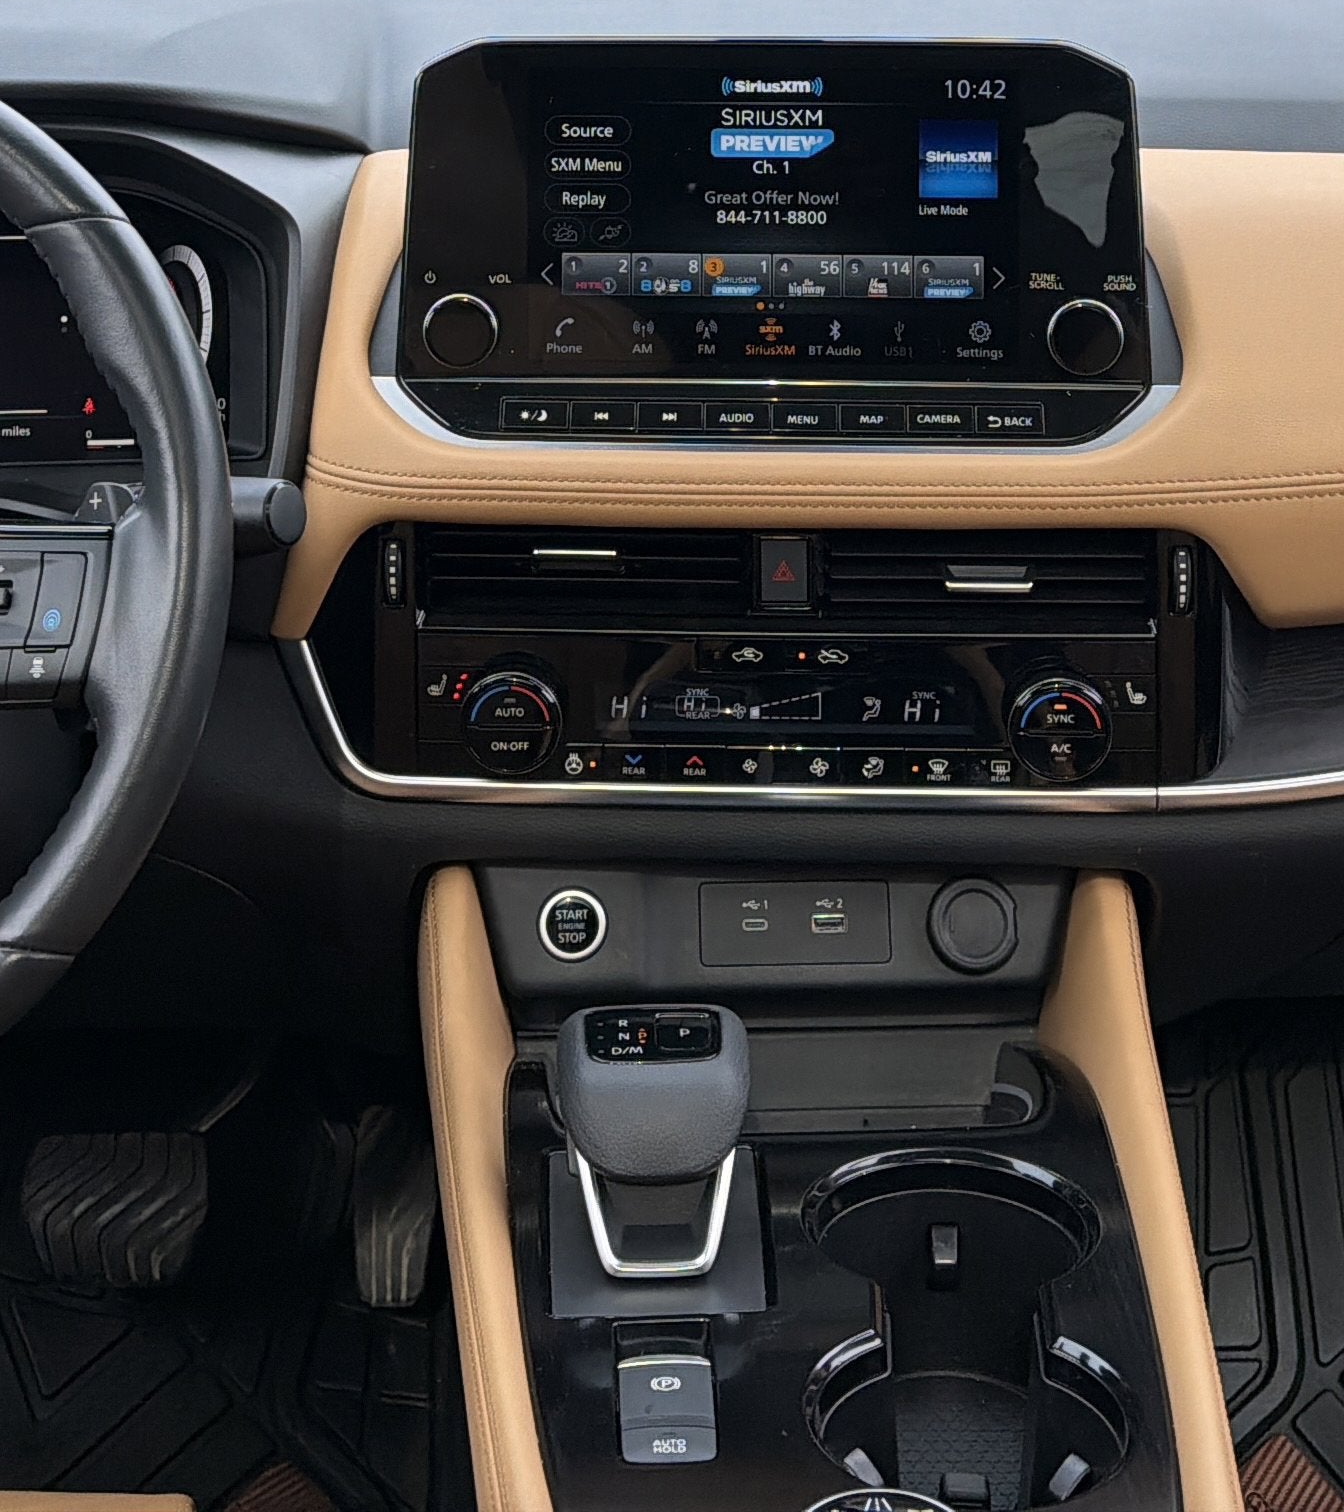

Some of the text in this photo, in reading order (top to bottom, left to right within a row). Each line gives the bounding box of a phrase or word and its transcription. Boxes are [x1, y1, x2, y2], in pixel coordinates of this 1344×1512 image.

[945, 80, 1006, 99] 10:42
[721, 108, 823, 126] SIRIUSXM
[561, 124, 613, 138] Source
[720, 135, 824, 152] PREVIEW
[925, 151, 992, 163] SiriusXM
[551, 158, 622, 172] SXM Menu
[753, 160, 790, 174] Ch. 1
[562, 192, 606, 208] Replay
[705, 190, 839, 205] Great Offer Now!
[919, 205, 969, 216] Live Mode
[716, 210, 827, 225] 844-711-8800
[618, 260, 628, 273] 2
[688, 260, 699, 273] 8
[760, 260, 767, 273] 1
[820, 261, 840, 275] 56
[882, 261, 911, 276] 114
[973, 262, 980, 276] 1
[488, 274, 512, 284] VOL
[1108, 275, 1133, 283] PUSH
[789, 282, 826, 297] highway
[1029, 281, 1064, 290] SCROLL
[1104, 282, 1136, 291] SOUND
[546, 342, 583, 354] Phone
[632, 344, 653, 354] AM
[698, 344, 716, 354] FM
[745, 345, 796, 356] SiriusXM
[808, 345, 862, 356] BT Audio
[956, 347, 1004, 361] Settings
[720, 413, 754, 424] AUDIO
[787, 415, 819, 425] MENU
[860, 414, 884, 425] MAP
[916, 414, 961, 425] CAMERA
[1005, 416, 1033, 427] BACK
[2, 425, 31, 438] miles
[686, 688, 709, 697] SYNC
[912, 691, 937, 700] SYNC
[494, 707, 525, 718] AUTO
[611, 695, 647, 719] Hi
[904, 700, 941, 723] Hi
[686, 712, 711, 720] REAR
[1046, 714, 1075, 724] SYNC
[1050, 744, 1072, 754] A/C
[622, 766, 646, 775] REAR
[683, 768, 707, 776] REAR
[927, 774, 951, 782] FRONT
[990, 775, 1011, 783] REAR
[837, 899, 843, 908] 2
[555, 909, 589, 921] START
[558, 922, 585, 930] ENGINE
[558, 932, 587, 944] STOP
[618, 1019, 628, 1027] R
[618, 1032, 630, 1040] N
[680, 1028, 690, 1037] P
[611, 1046, 644, 1055] D/M
[653, 1445, 687, 1453] HOLD
